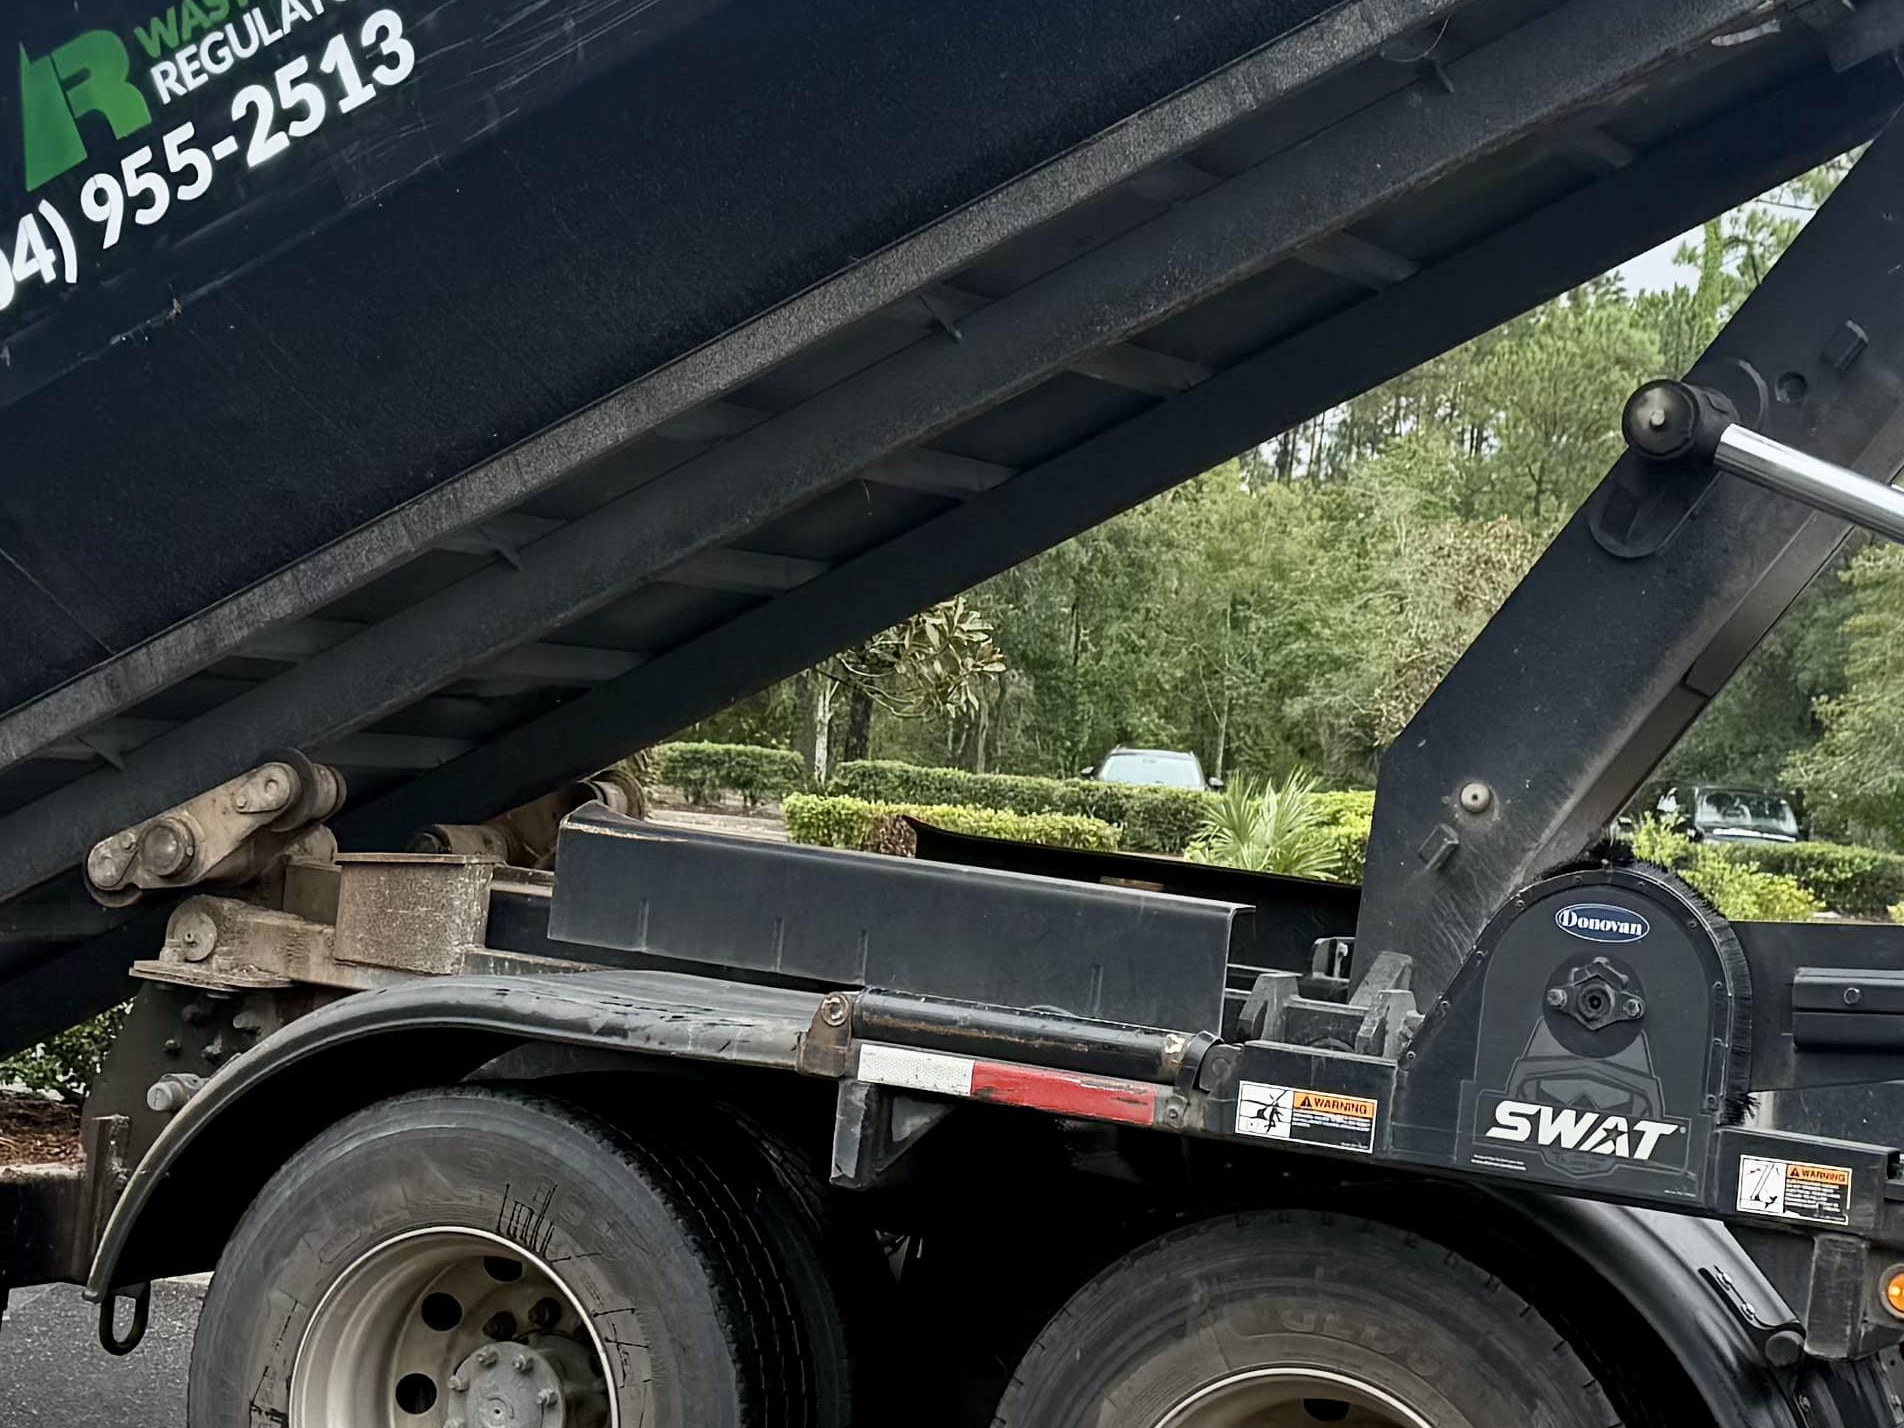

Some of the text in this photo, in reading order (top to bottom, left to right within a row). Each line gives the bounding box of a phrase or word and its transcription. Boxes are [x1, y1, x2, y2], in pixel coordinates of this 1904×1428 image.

[80, 9, 415, 249] 955-2513
[1558, 910, 1643, 935] Donovan
[1313, 1097, 1368, 1115] WARNING
[1485, 1100, 1680, 1160] SWAT
[1801, 1168, 1846, 1183] WARNING
